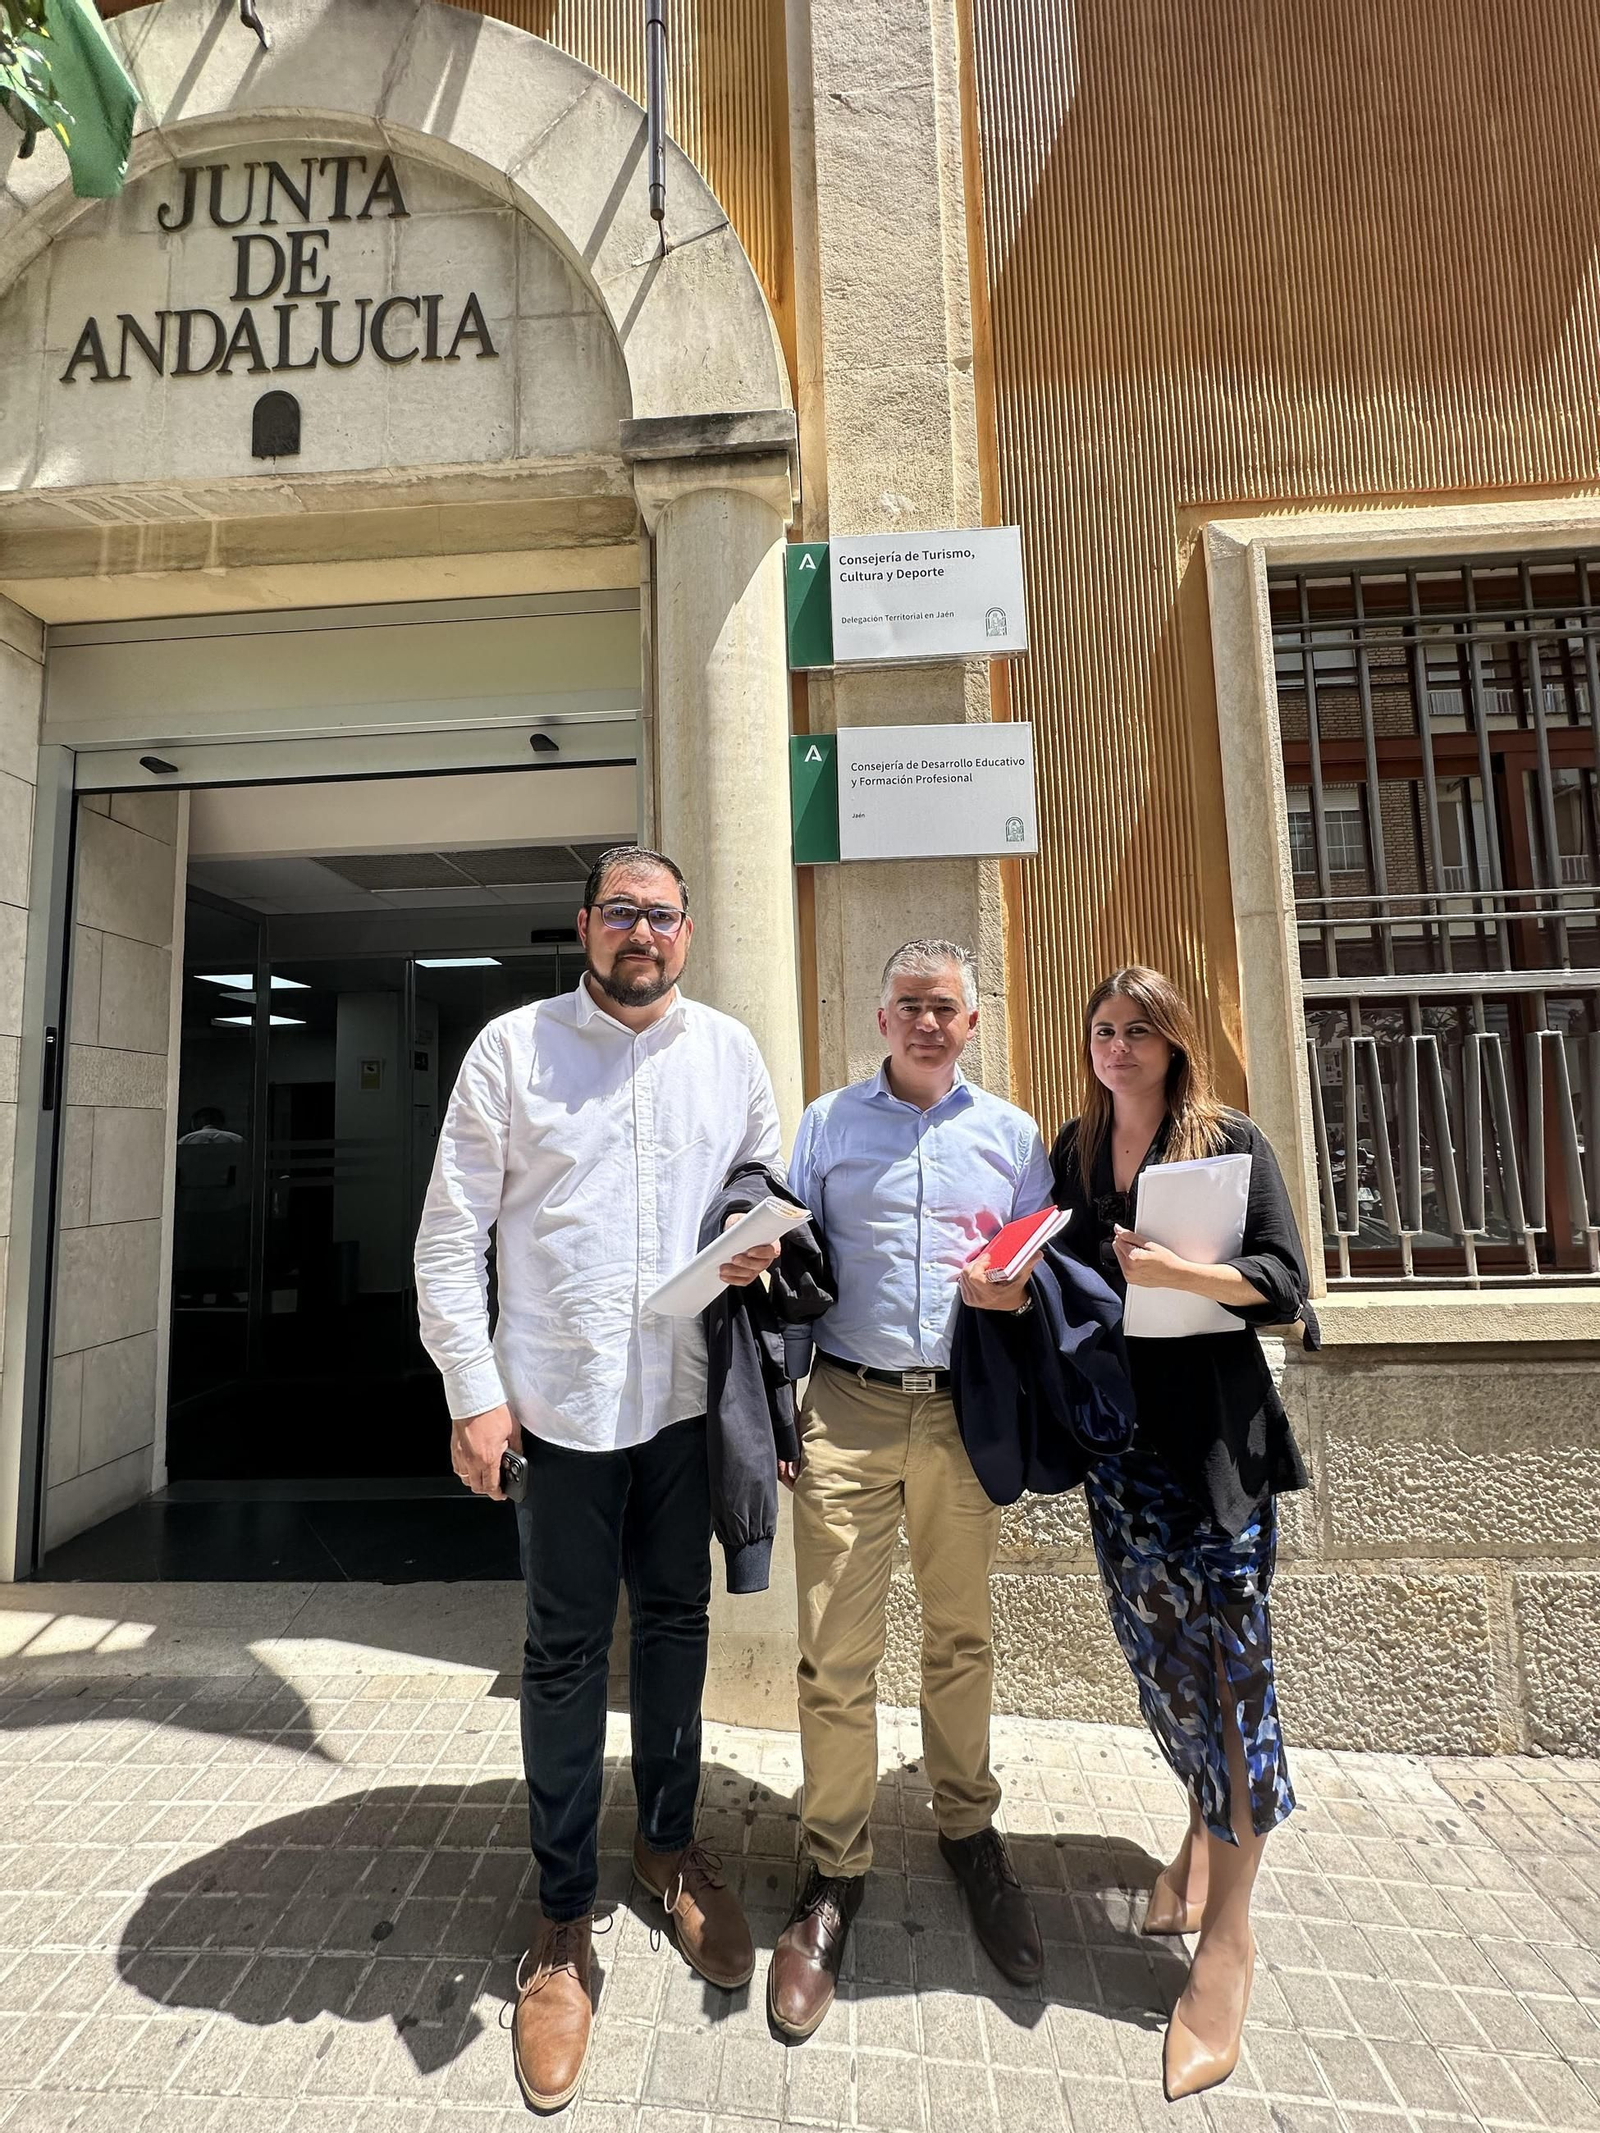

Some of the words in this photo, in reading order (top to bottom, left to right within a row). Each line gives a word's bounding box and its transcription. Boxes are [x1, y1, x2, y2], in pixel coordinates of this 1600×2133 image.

[157, 154, 411, 233] JUNTA
[230, 229, 331, 301] DE
[59, 291, 499, 384] ANDALUCIA
[839, 551, 901, 566] Consejería
[905, 551, 919, 562] de
[922, 549, 975, 561] Turismo,
[840, 571, 883, 582] Cultura
[886, 572, 893, 582] y
[896, 567, 944, 580] Deporte
[841, 614, 883, 625] Delegación
[885, 612, 923, 621] Territorial
[936, 611, 954, 619] Jaén
[851, 760, 903, 773] Consejería
[906, 760, 918, 770] de
[921, 758, 973, 769] Desarrollo
[976, 757, 1025, 767] Educativo
[851, 778, 857, 788] y
[859, 774, 913, 786] Formación
[915, 773, 973, 784] Profesional
